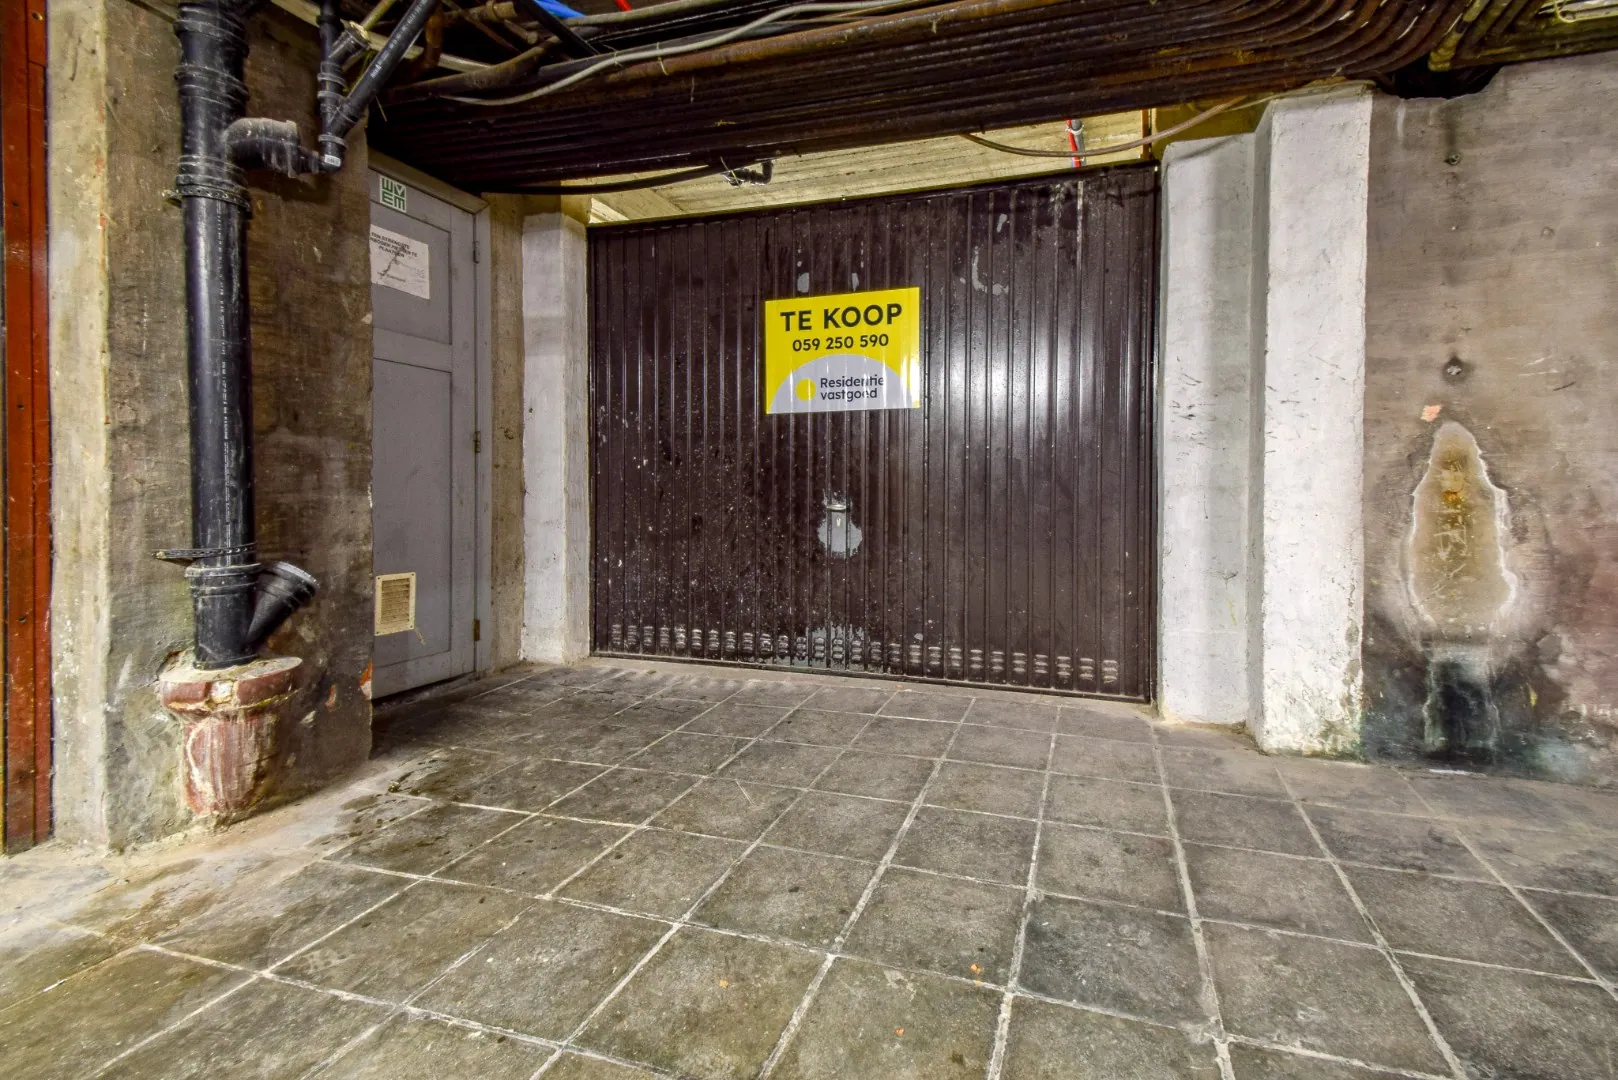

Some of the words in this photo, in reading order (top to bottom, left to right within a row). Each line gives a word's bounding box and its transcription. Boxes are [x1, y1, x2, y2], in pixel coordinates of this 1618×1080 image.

[780, 310, 812, 332] TE
[823, 303, 903, 329] KOOP
[792, 338, 820, 352] 059
[826, 336, 854, 349] 250
[860, 333, 889, 348] 590
[820, 374, 884, 388] Residentie
[820, 388, 878, 402] vastgoed
